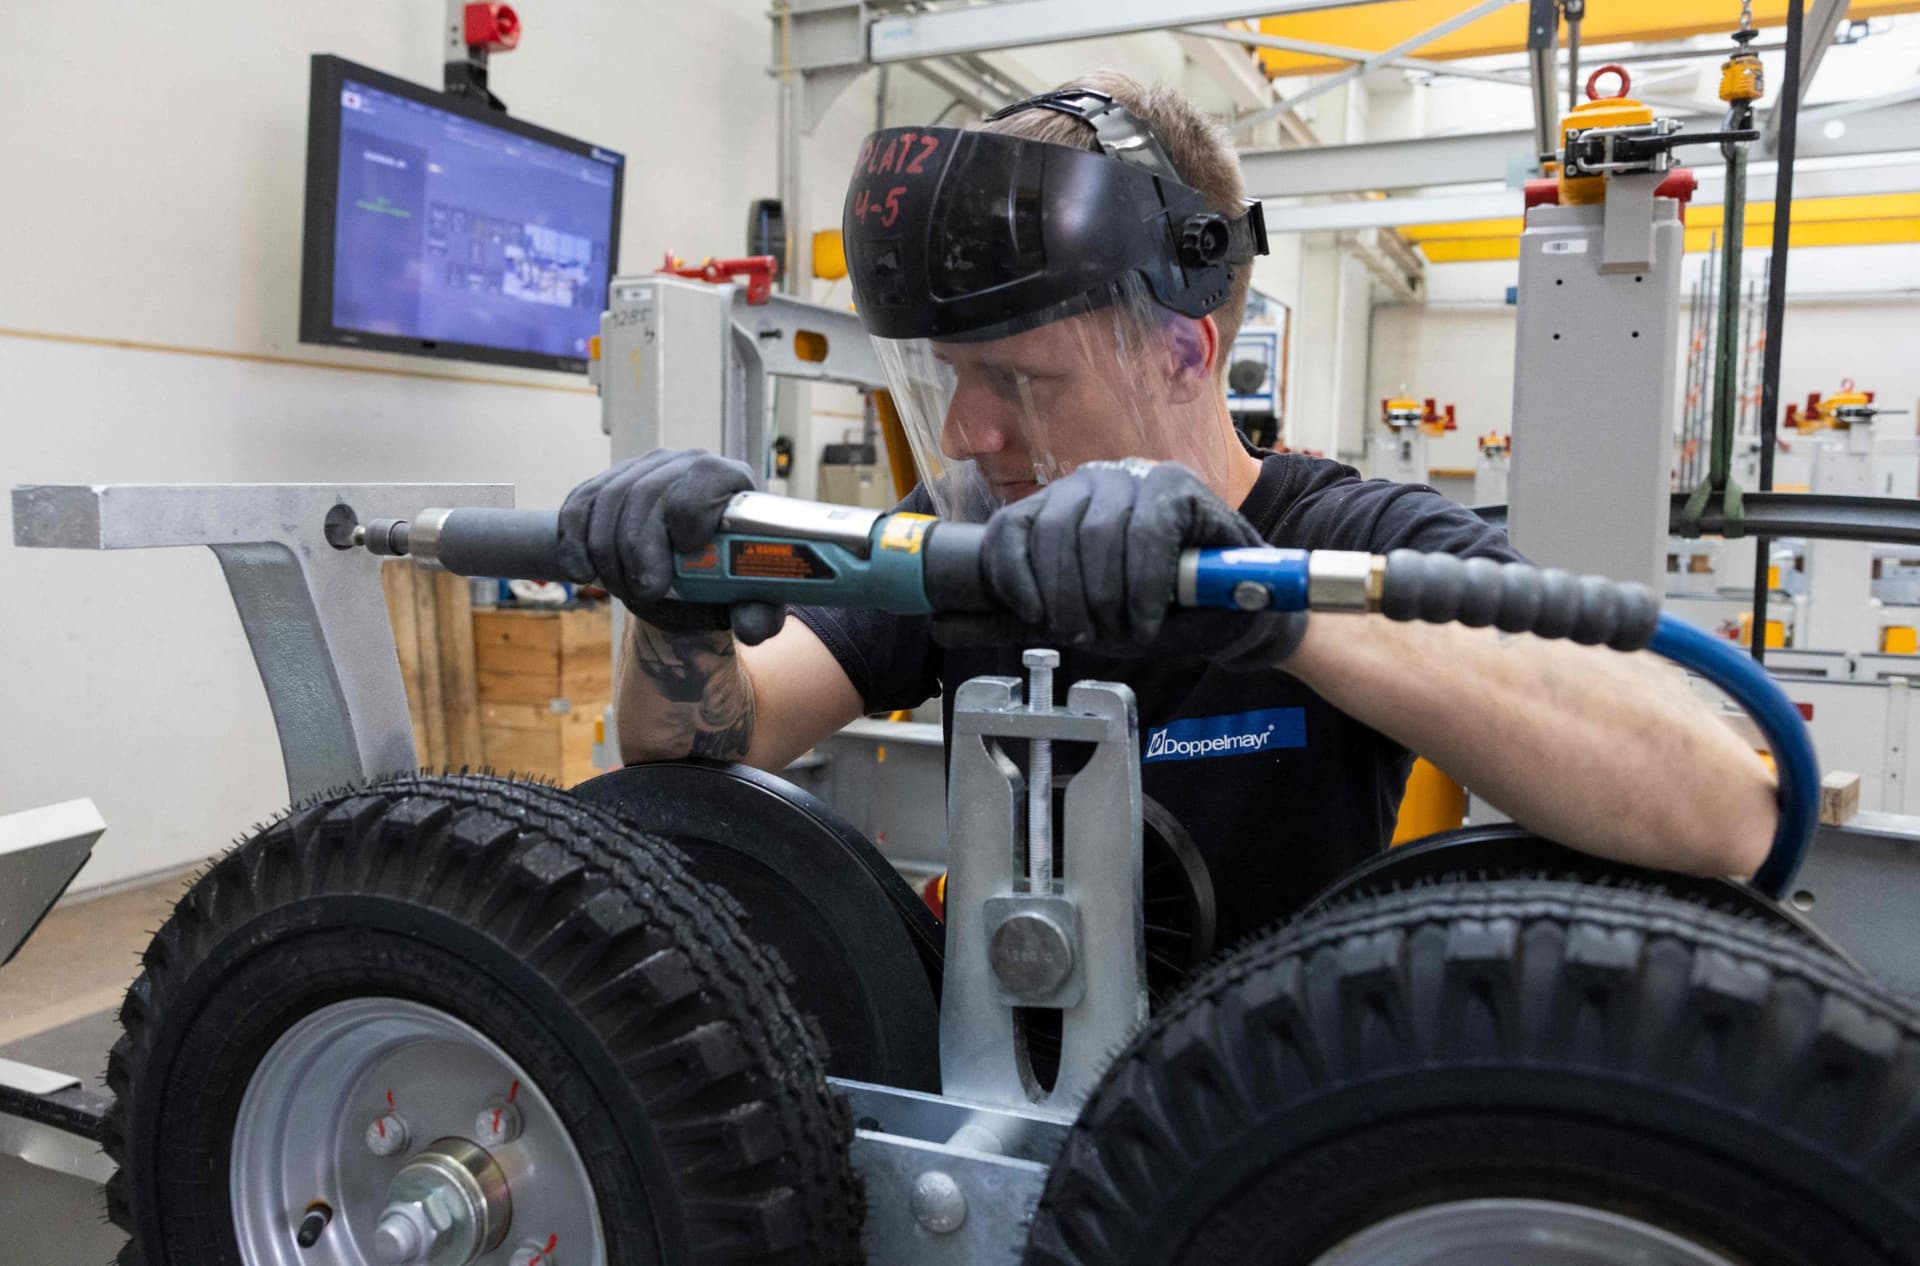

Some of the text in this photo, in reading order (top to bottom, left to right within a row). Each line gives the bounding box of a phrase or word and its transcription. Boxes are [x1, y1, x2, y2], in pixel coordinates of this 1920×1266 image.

[855, 133, 939, 177] PLATZ
[855, 186, 907, 227] 4-5
[1164, 731, 1270, 757] Doppelmayr
